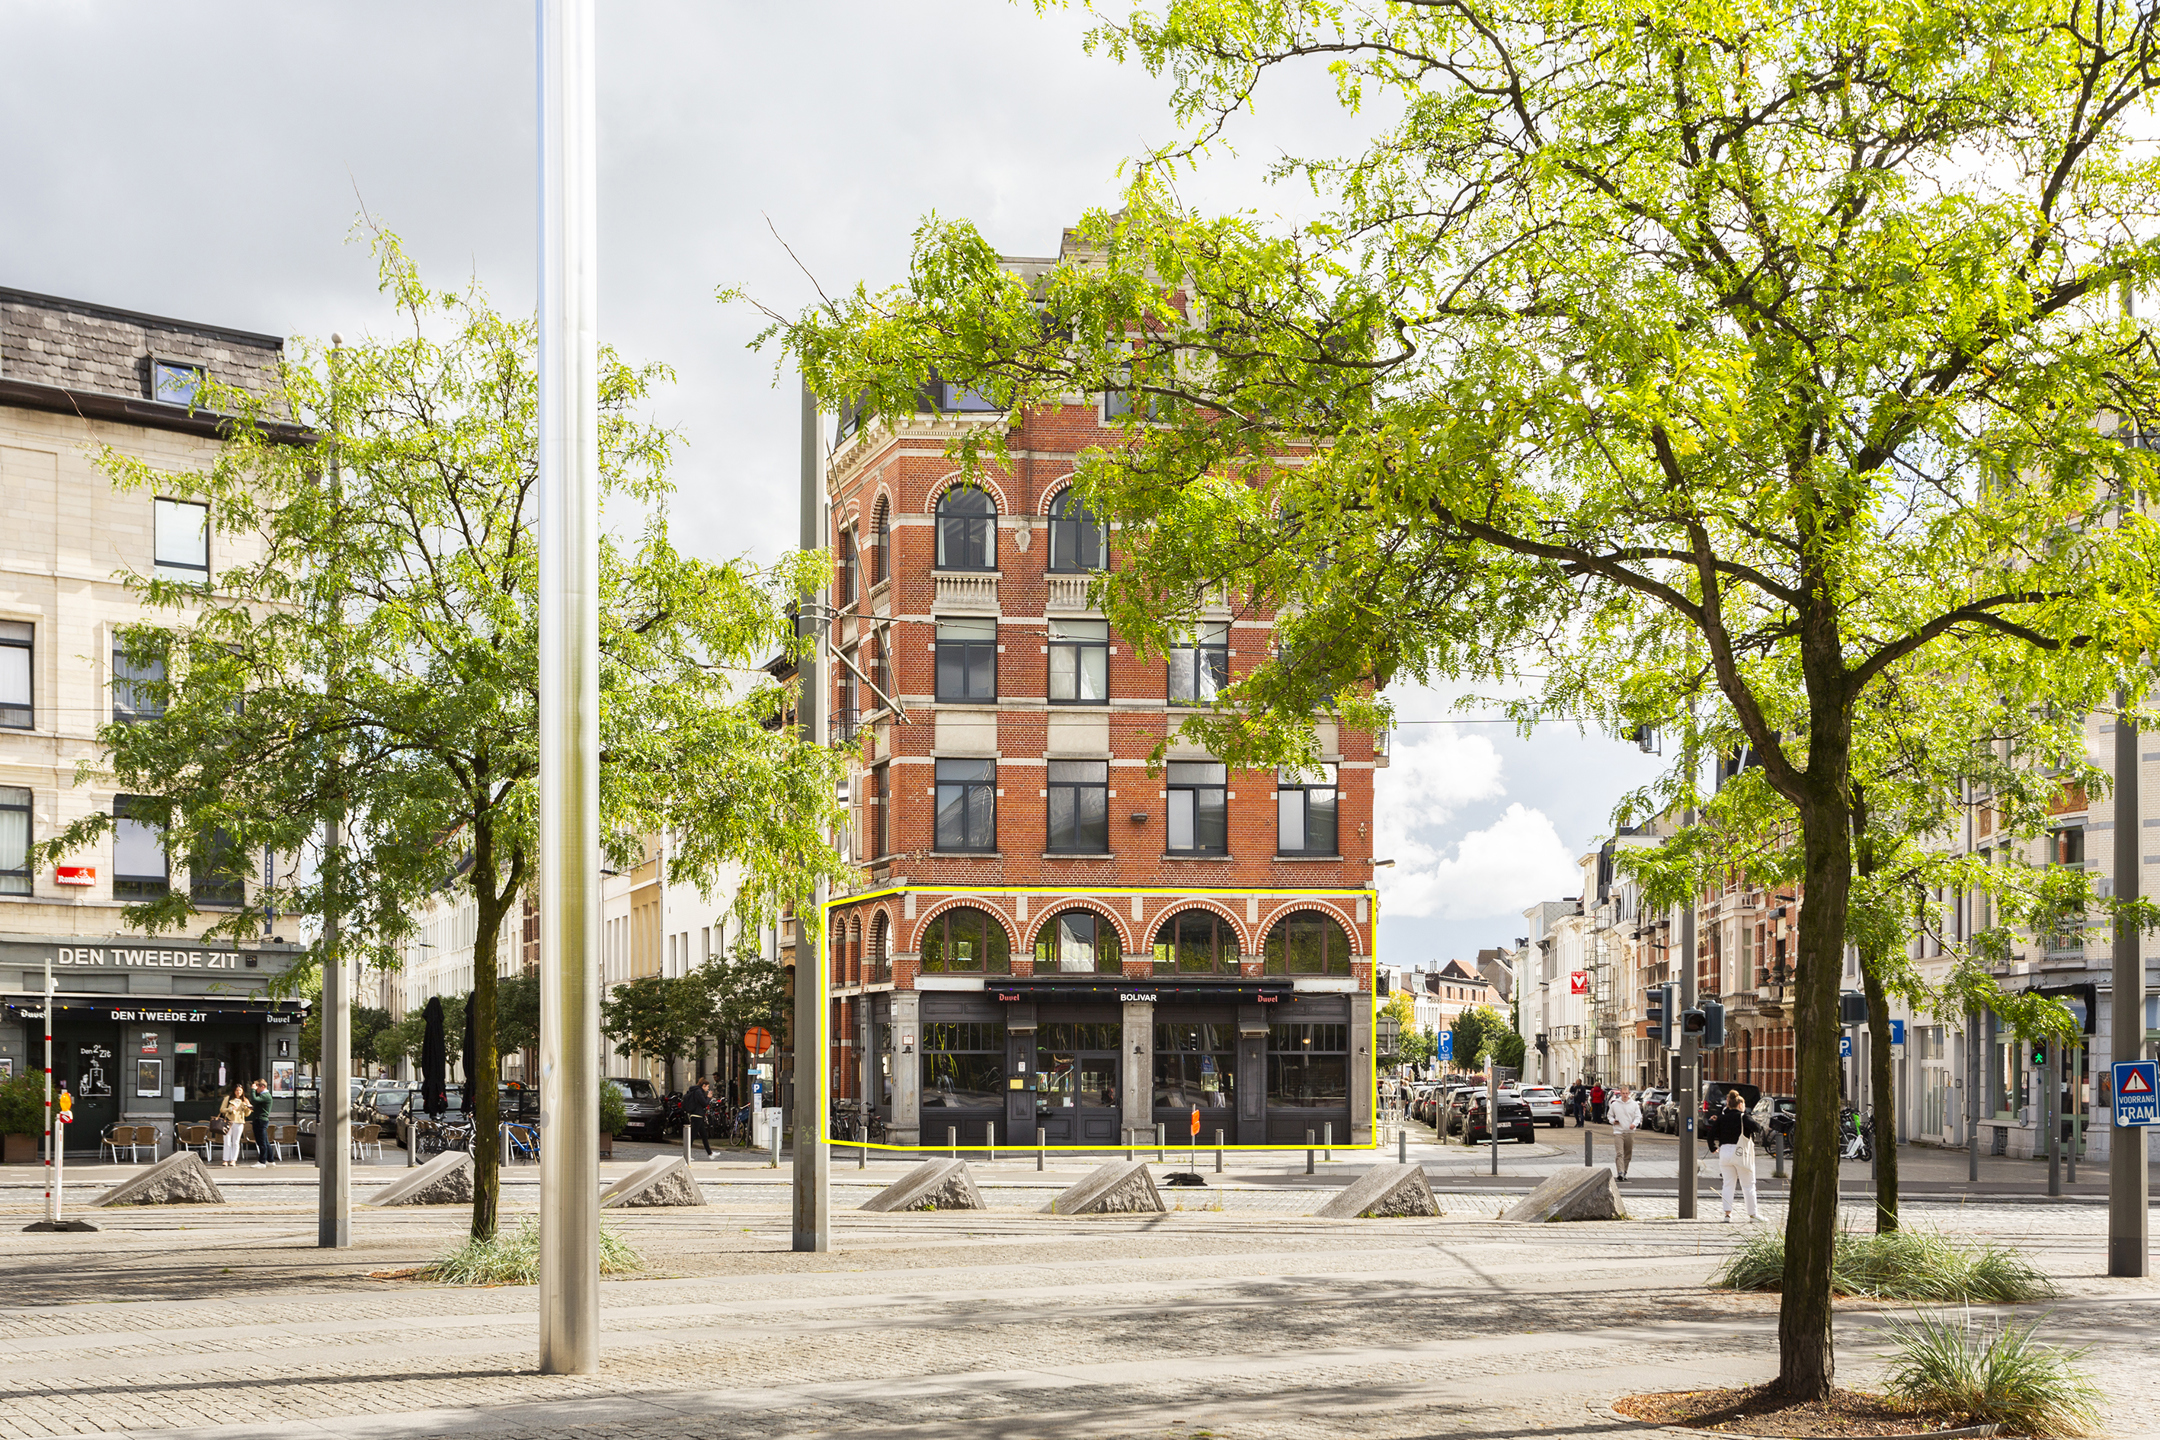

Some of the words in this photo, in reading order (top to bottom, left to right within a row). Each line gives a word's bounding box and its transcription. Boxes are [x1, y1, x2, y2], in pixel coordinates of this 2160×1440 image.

[58, 948, 104, 965] DEN
[110, 949, 202, 967] TWEEDE
[207, 952, 239, 969] ZIT
[999, 993, 1020, 1001] Duvel
[1120, 993, 1157, 1002] BOLIVAR
[1257, 994, 1278, 1003] Duvel
[111, 1011, 135, 1020] DEN
[138, 1012, 187, 1021] TWEEDE
[189, 1013, 207, 1022] ZIT
[266, 1014, 290, 1023] Duvel
[1440, 1032, 1450, 1046] P
[1839, 1040, 1850, 1054] P
[99, 1050, 112, 1058] Zit
[753, 1084, 760, 1093] P
[2119, 1095, 2155, 1104] VOORRANG
[2120, 1106, 2154, 1120] TRAM
